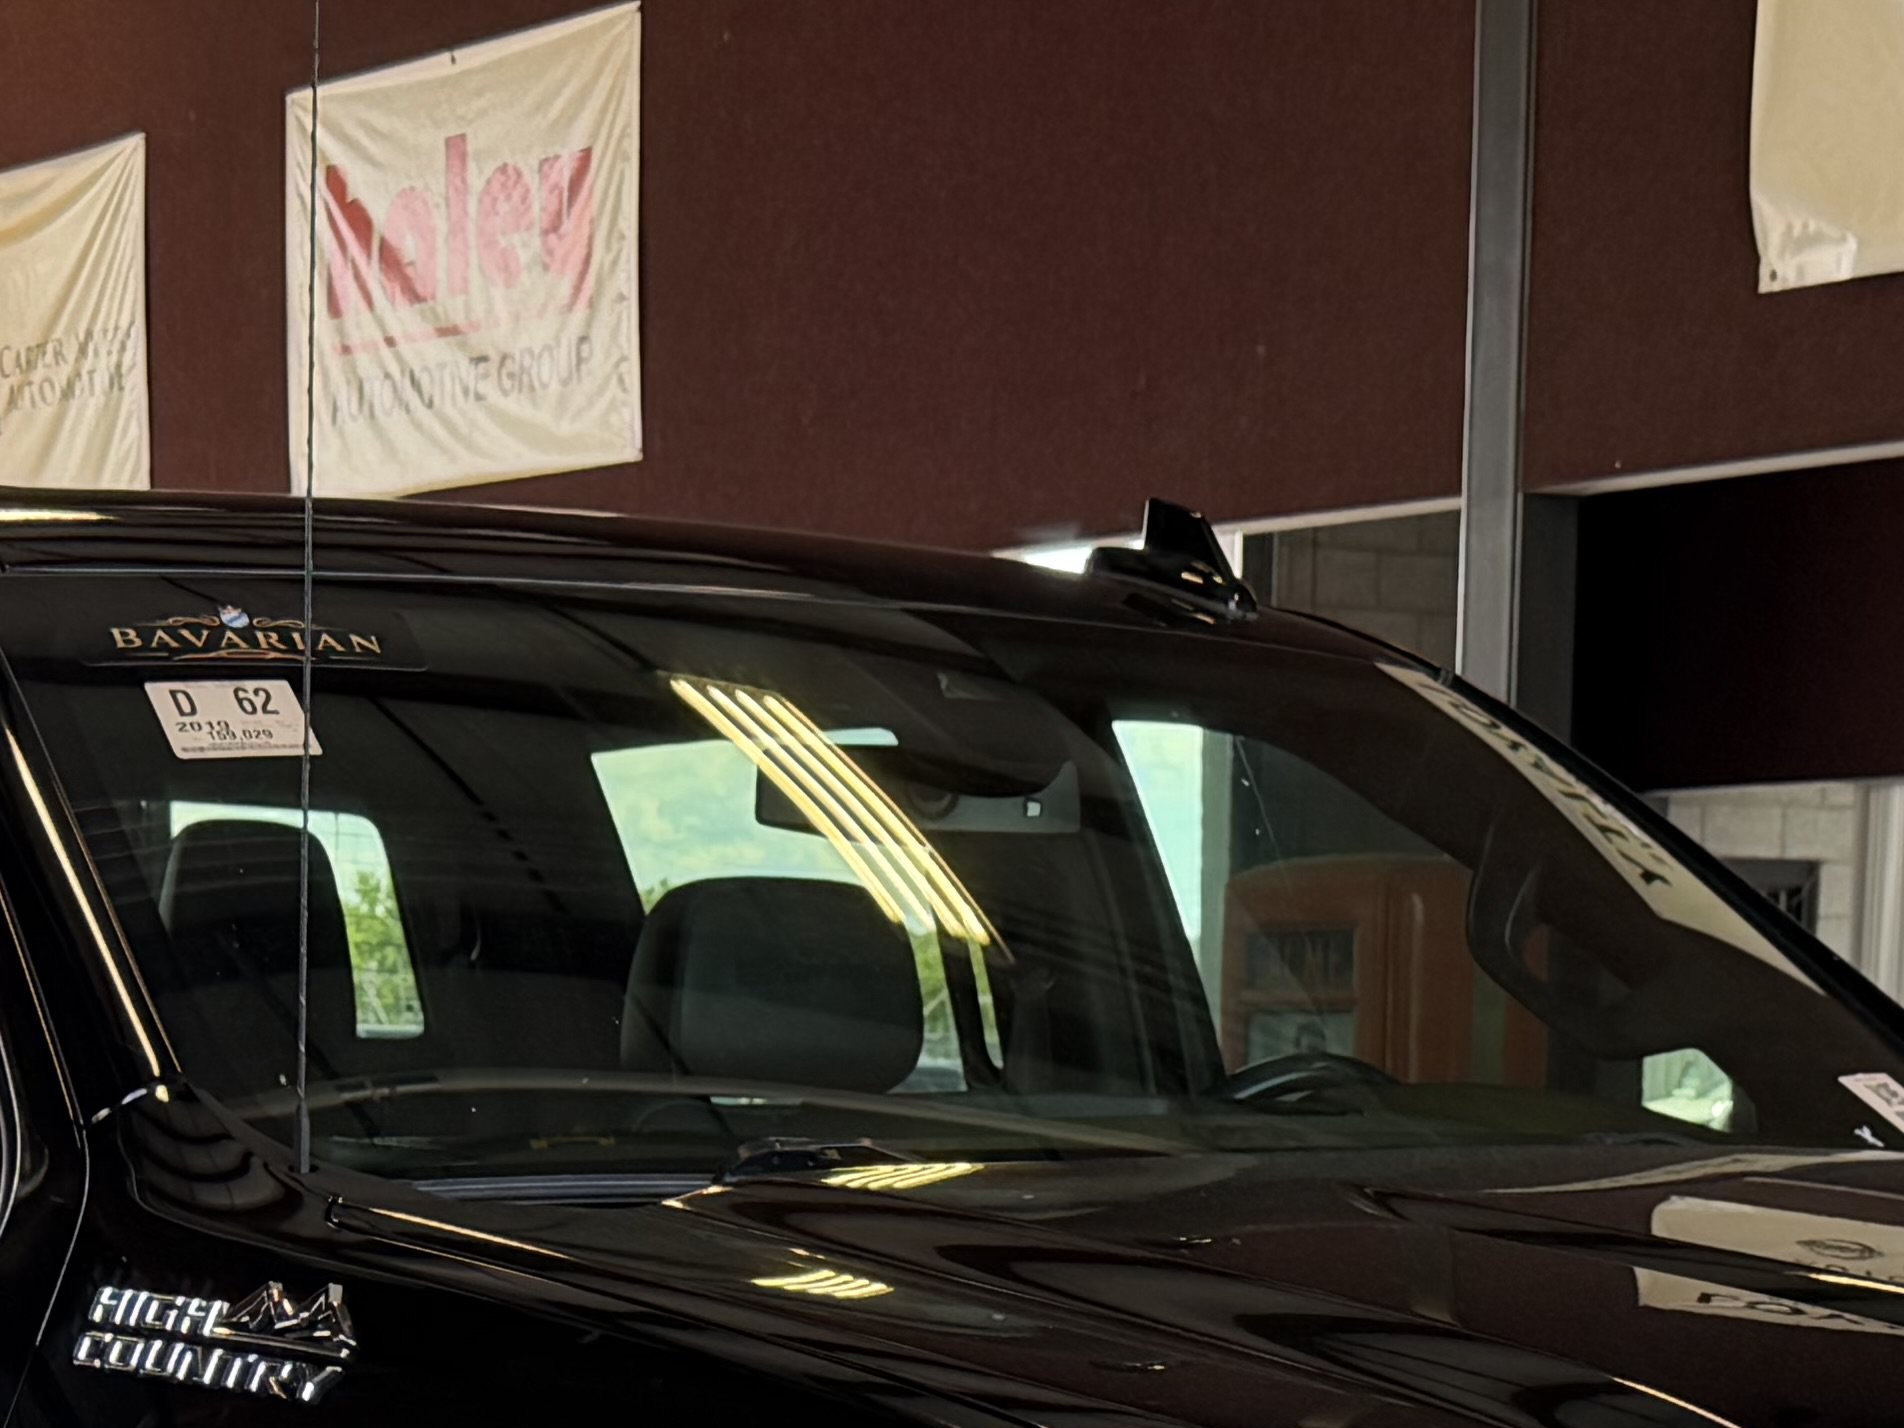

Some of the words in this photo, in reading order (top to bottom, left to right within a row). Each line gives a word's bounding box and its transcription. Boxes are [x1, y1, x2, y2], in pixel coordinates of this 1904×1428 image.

[324, 132, 594, 320] haley
[496, 335, 594, 399] GROUP
[110, 627, 383, 654] BAVARIAN
[169, 689, 198, 718] D
[233, 687, 280, 717] 62
[88, 1286, 230, 1337] HIGH
[72, 1332, 344, 1402] COUNTRY
